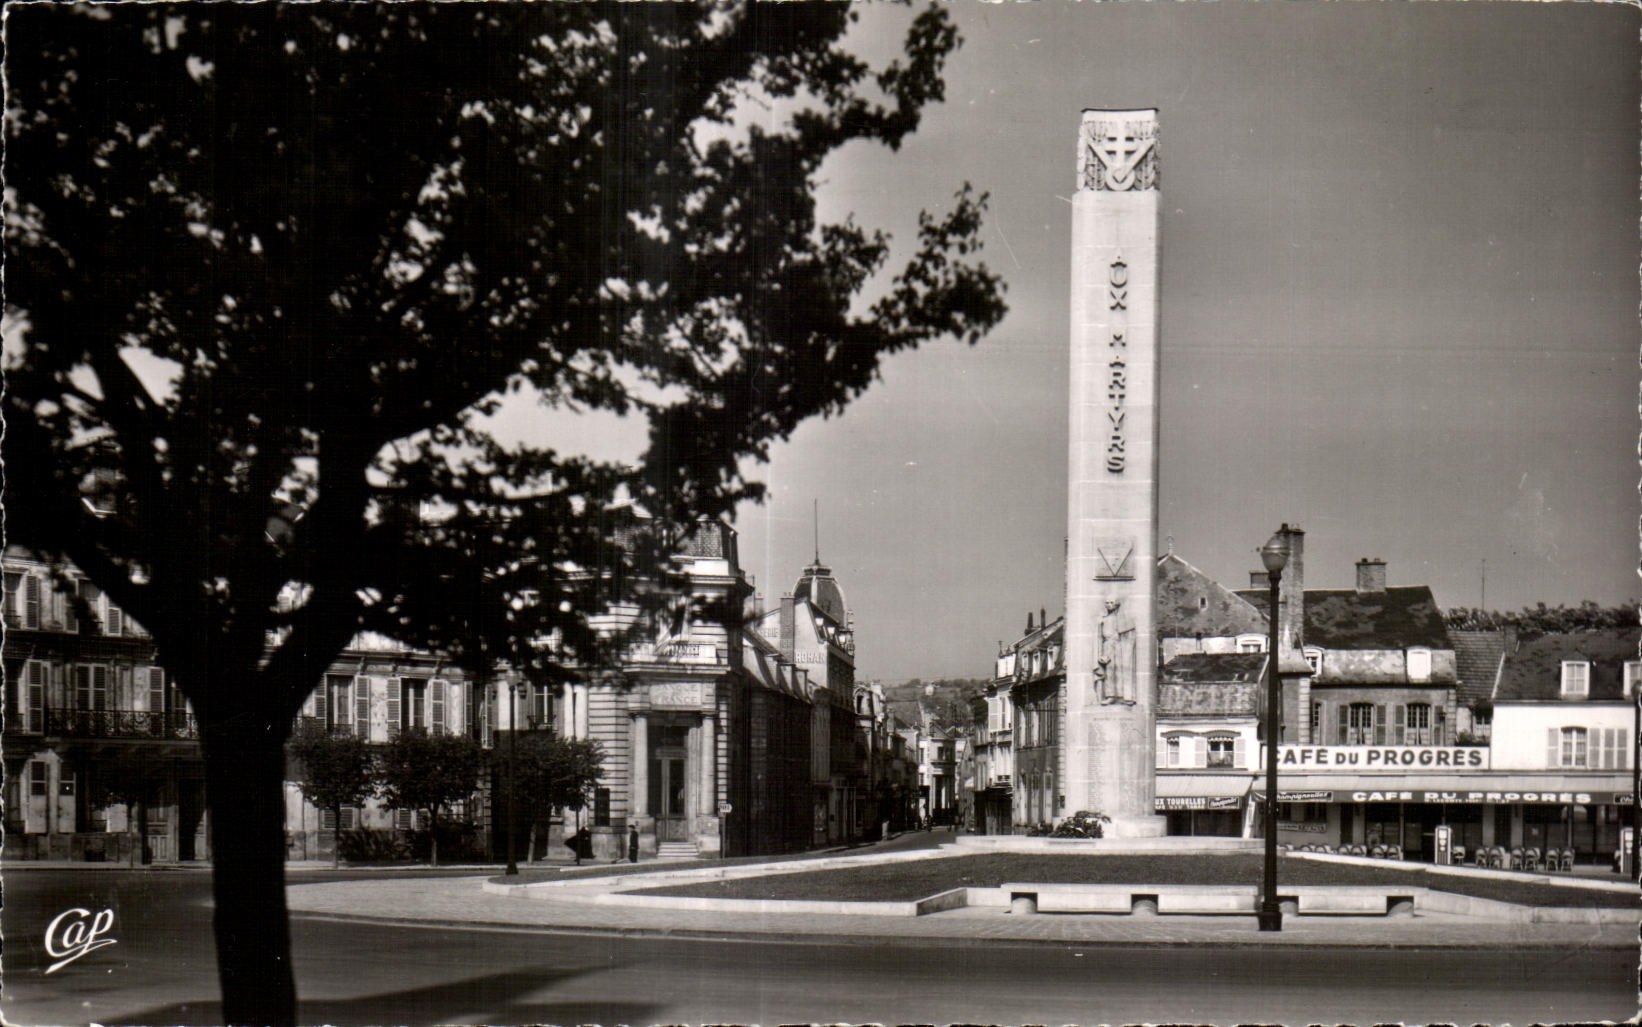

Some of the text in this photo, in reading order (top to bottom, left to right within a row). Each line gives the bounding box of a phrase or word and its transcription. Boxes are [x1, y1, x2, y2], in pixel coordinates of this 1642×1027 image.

[1107, 255, 1128, 474] AUX MARTYRS
[1335, 752, 1359, 765] DU
[1166, 797, 1206, 805] TOURELLES
[1424, 791, 1456, 800] DU
